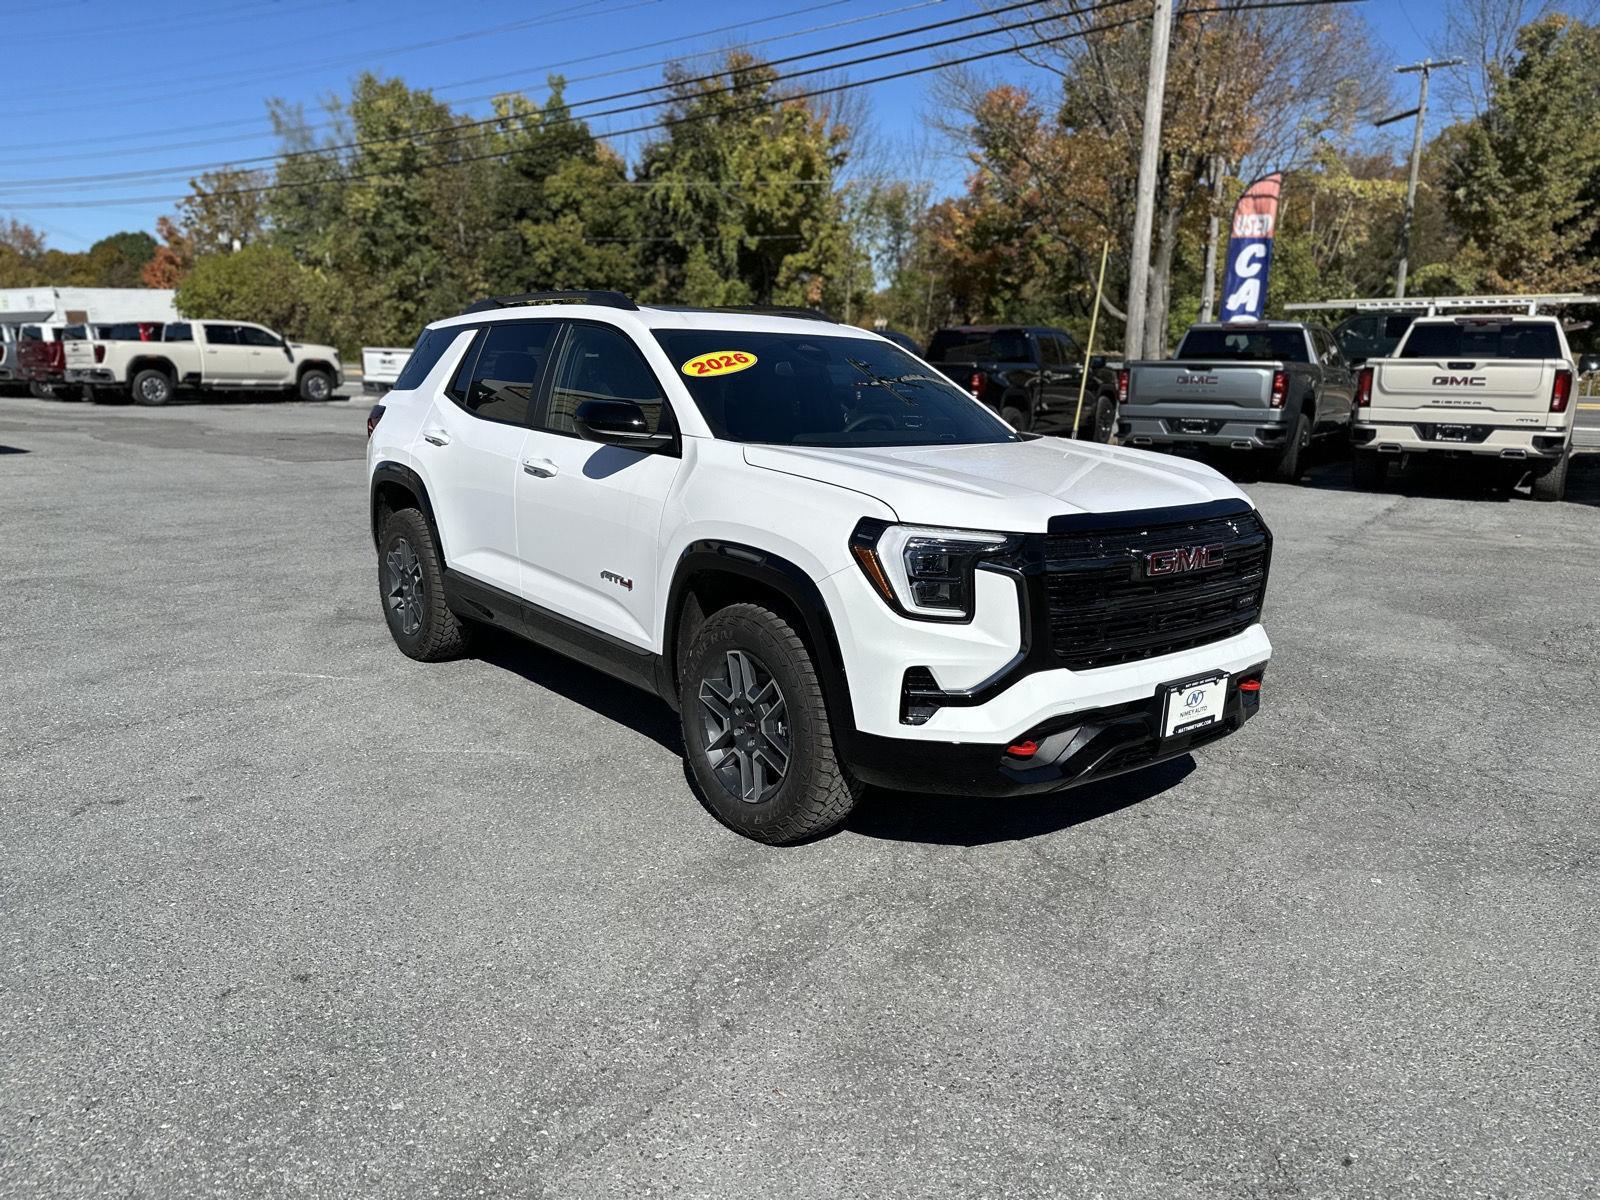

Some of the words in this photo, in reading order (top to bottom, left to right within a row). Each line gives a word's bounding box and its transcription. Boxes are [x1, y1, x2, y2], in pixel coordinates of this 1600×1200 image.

[1234, 214, 1273, 235] USED
[1226, 243, 1267, 322] CA
[692, 353, 749, 375] 2026
[1177, 376, 1218, 384] GMC
[1432, 376, 1486, 386] GMC
[1147, 543, 1224, 576] GMC
[600, 570, 633, 591] AT4
[1180, 709, 1195, 718] NIMEY
[1195, 705, 1207, 713] AUTO
